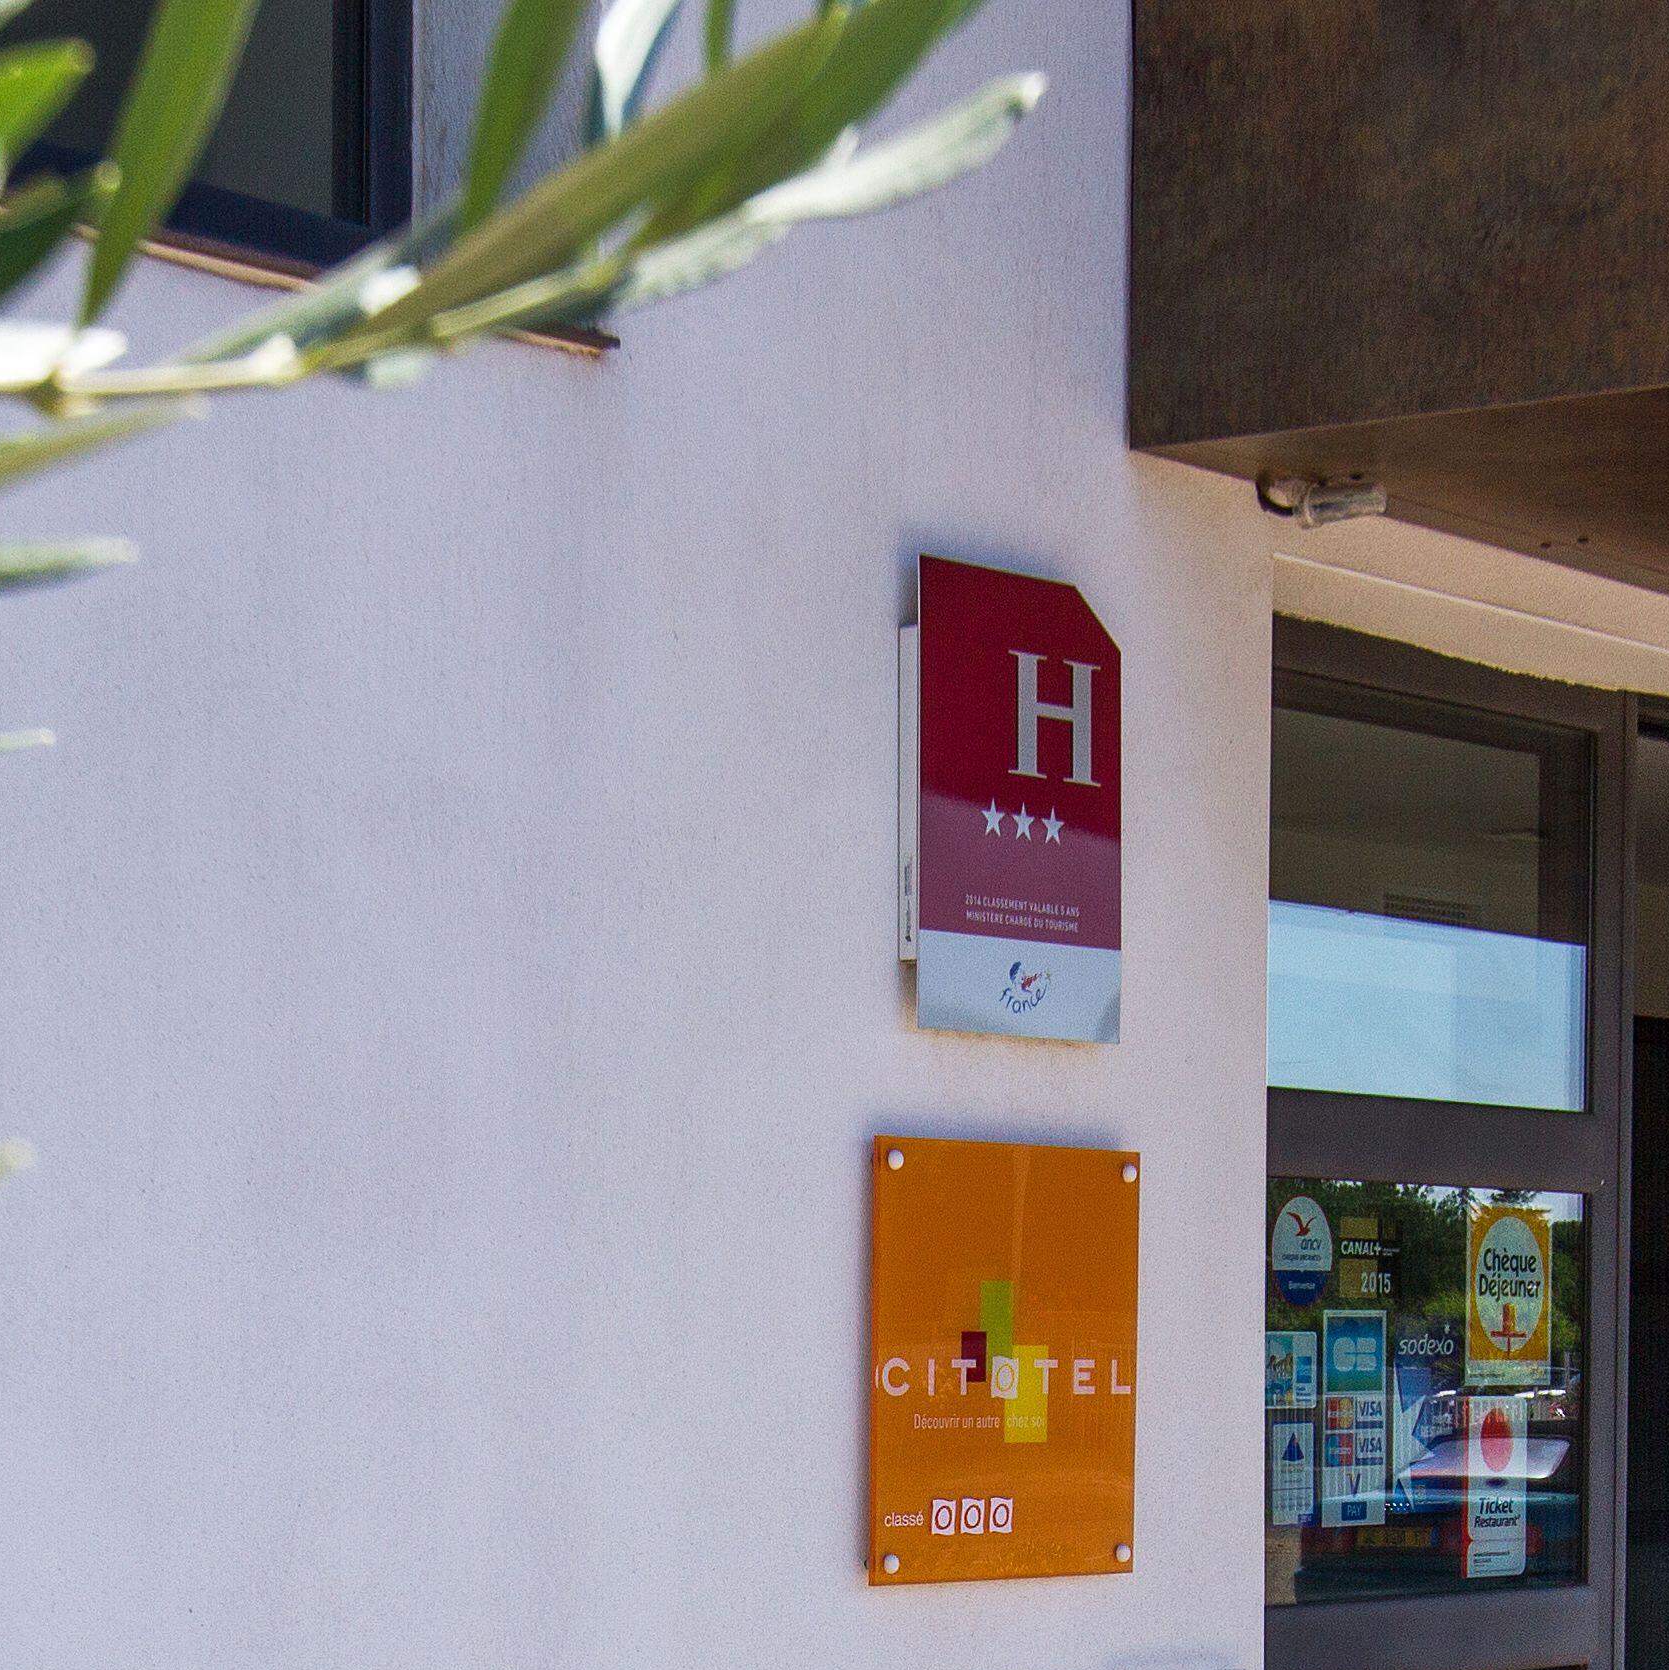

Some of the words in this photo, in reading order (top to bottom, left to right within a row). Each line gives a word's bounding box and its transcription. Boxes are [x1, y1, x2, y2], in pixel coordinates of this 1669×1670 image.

[1007, 649, 1102, 788] H
[982, 896, 1028, 911] CLASSEMENT
[1029, 901, 1059, 916] VALABLE
[1045, 919, 1079, 934] TOURISME
[1340, 1241, 1382, 1257] CANAL+
[1483, 1247, 1537, 1278] Chèque
[1360, 1271, 1391, 1295] 2015
[1478, 1272, 1541, 1302] Déjeuner
[1397, 1333, 1455, 1356] sodexo
[881, 1355, 1132, 1399] CITOTEL
[1358, 1400, 1383, 1417] VISA
[913, 1413, 960, 1430] Découvrir
[962, 1417, 974, 1429] un
[975, 1415, 1001, 1429] autre
[1006, 1412, 1029, 1428] chez
[1358, 1437, 1383, 1453] VISA
[1346, 1504, 1362, 1517] PAY
[1478, 1496, 1514, 1515] Ticket
[884, 1511, 924, 1528] classé
